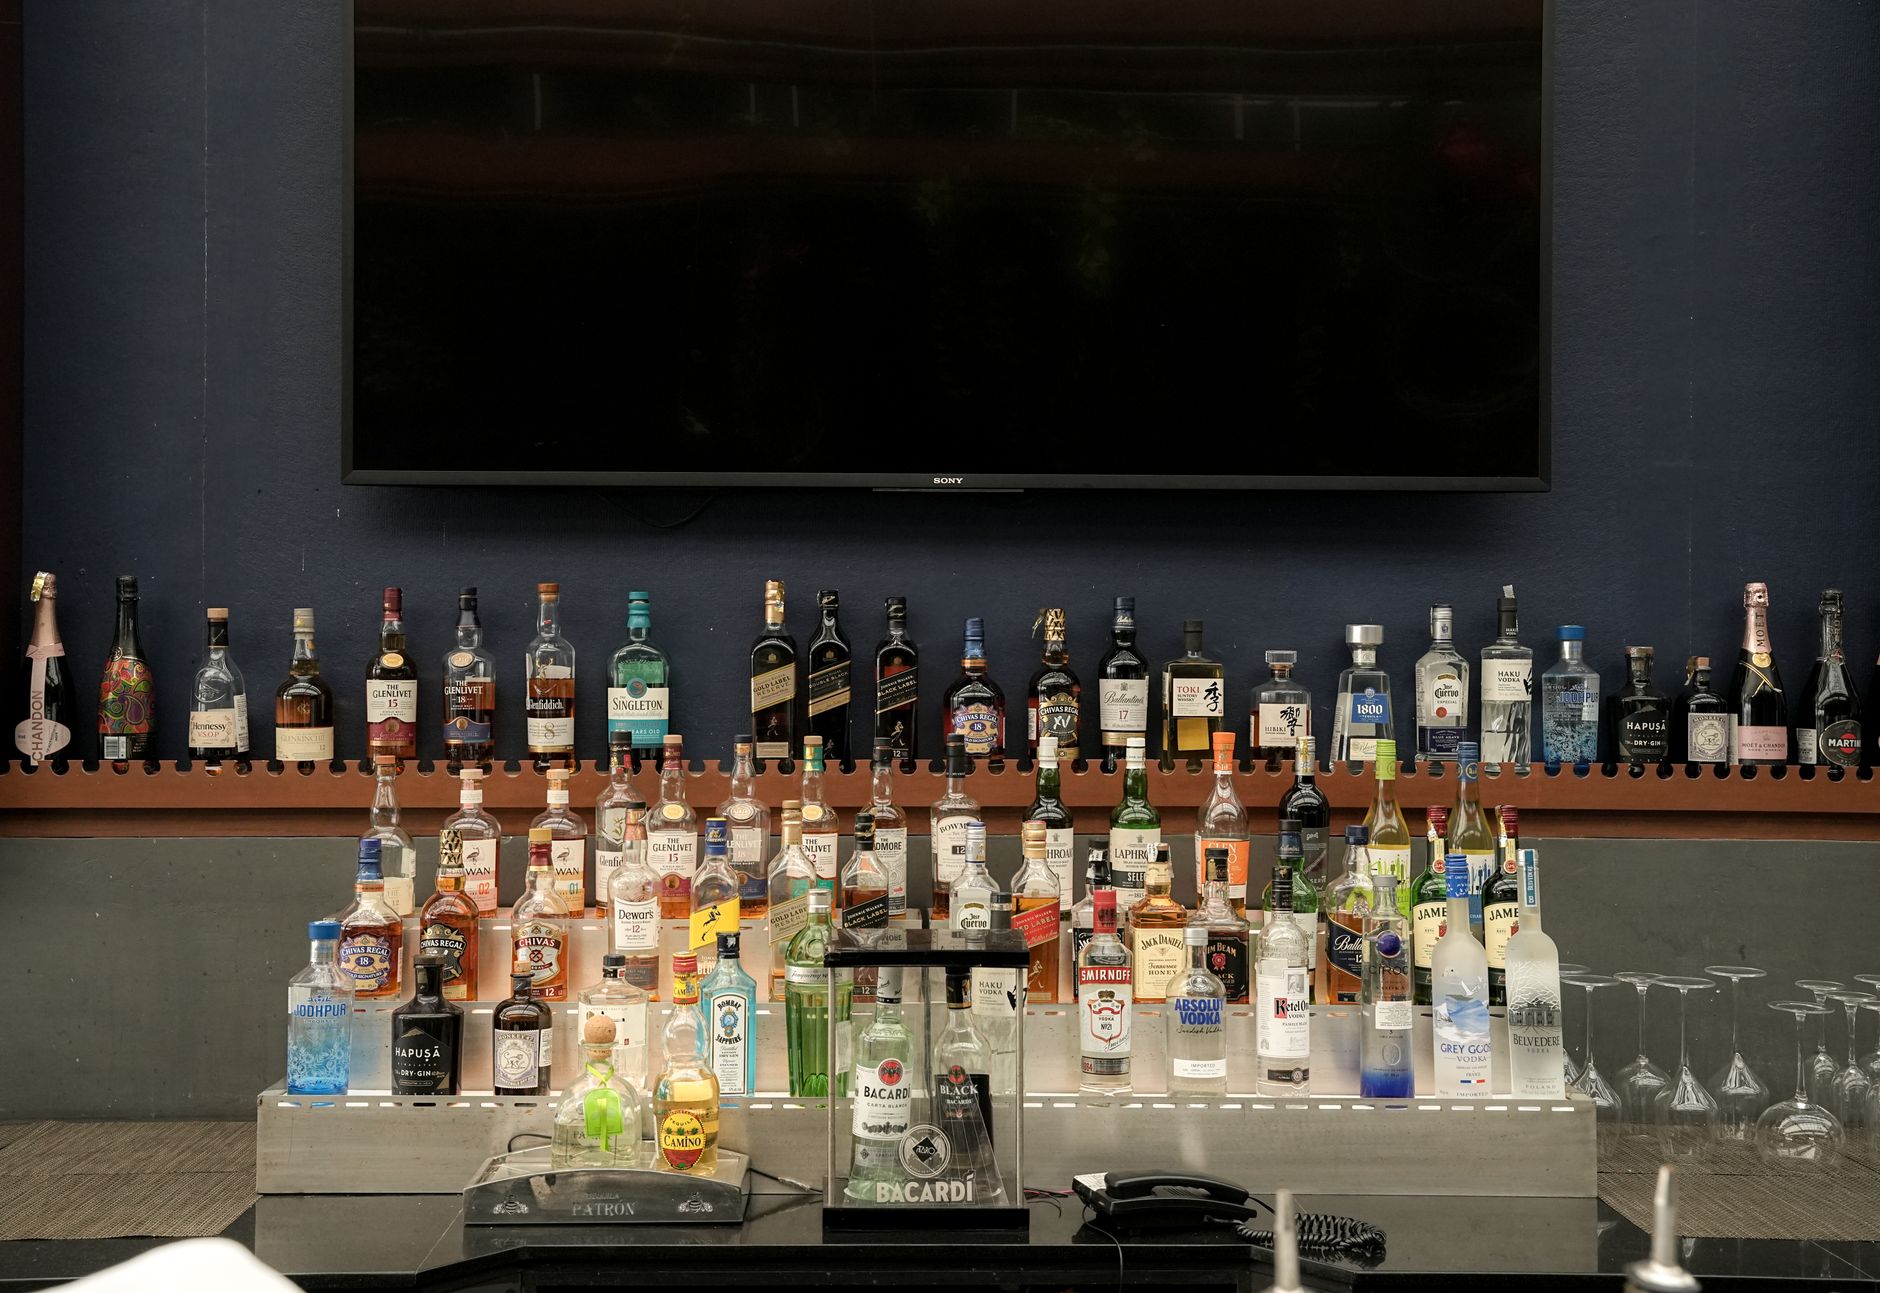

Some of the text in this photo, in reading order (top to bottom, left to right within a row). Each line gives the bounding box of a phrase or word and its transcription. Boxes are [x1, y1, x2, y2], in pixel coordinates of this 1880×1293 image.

[831, 671, 848, 680] BLACK
[753, 676, 791, 693] GOLD LABEL
[877, 687, 898, 697] BLACK
[898, 680, 917, 689] LABEL
[372, 690, 412, 698] GLENLIVET
[444, 686, 483, 695] GLENLIVET
[1434, 687, 1459, 698] Cuervo
[388, 699, 398, 707] 15
[612, 697, 664, 711] SINGLETON
[1041, 706, 1079, 715] CHIVAS REGAL
[1118, 710, 1128, 719] 17
[1357, 704, 1383, 715] 1800
[956, 714, 997, 722] CHIVAS REGAL
[1053, 715, 1071, 730] XV
[31, 690, 43, 762] CHANDON
[192, 722, 226, 731] Hennessy
[973, 722, 982, 730] 18
[939, 822, 967, 834] BOWM
[652, 843, 692, 852] GLENLIVET
[802, 845, 831, 853] ENLIVET
[668, 853, 678, 863] 15
[478, 882, 490, 895] 02
[569, 882, 579, 895] 01
[618, 909, 654, 920] Dewar's
[770, 907, 808, 923] GOLD LABE
[844, 908, 888, 928] BLACK LABEL
[1417, 908, 1447, 921] JAME
[1489, 908, 1519, 921] JAME
[960, 917, 987, 929] Cuervo
[1030, 915, 1056, 927] LABEL
[632, 925, 640, 933] 12
[420, 940, 463, 949] CHIVAS REGAL
[519, 937, 556, 947] CHIVAS
[1141, 937, 1158, 951] JACK
[341, 946, 388, 956] CHIVAS REGAL
[1217, 942, 1237, 957] BEAM
[359, 957, 369, 965] 18
[1081, 969, 1131, 981] SMIRNOFF
[862, 986, 871, 994] 12
[979, 981, 1002, 989] HAKU
[545, 987, 554, 996] 12
[294, 1003, 347, 1017] JODHPUR
[717, 1000, 742, 1011] BOMBAY
[1175, 998, 1224, 1013] ABSOLUT
[1276, 1000, 1300, 1016] Ketel
[1180, 1011, 1221, 1025] VODKA
[715, 1033, 742, 1045] SAPPHIRE
[1513, 1033, 1560, 1047] BELVEDERE
[1441, 1043, 1465, 1054] GREY
[940, 1085, 978, 1096] BLACK
[876, 1174, 974, 1204] BACARDÍ
[572, 1200, 636, 1217] PATRÓN
